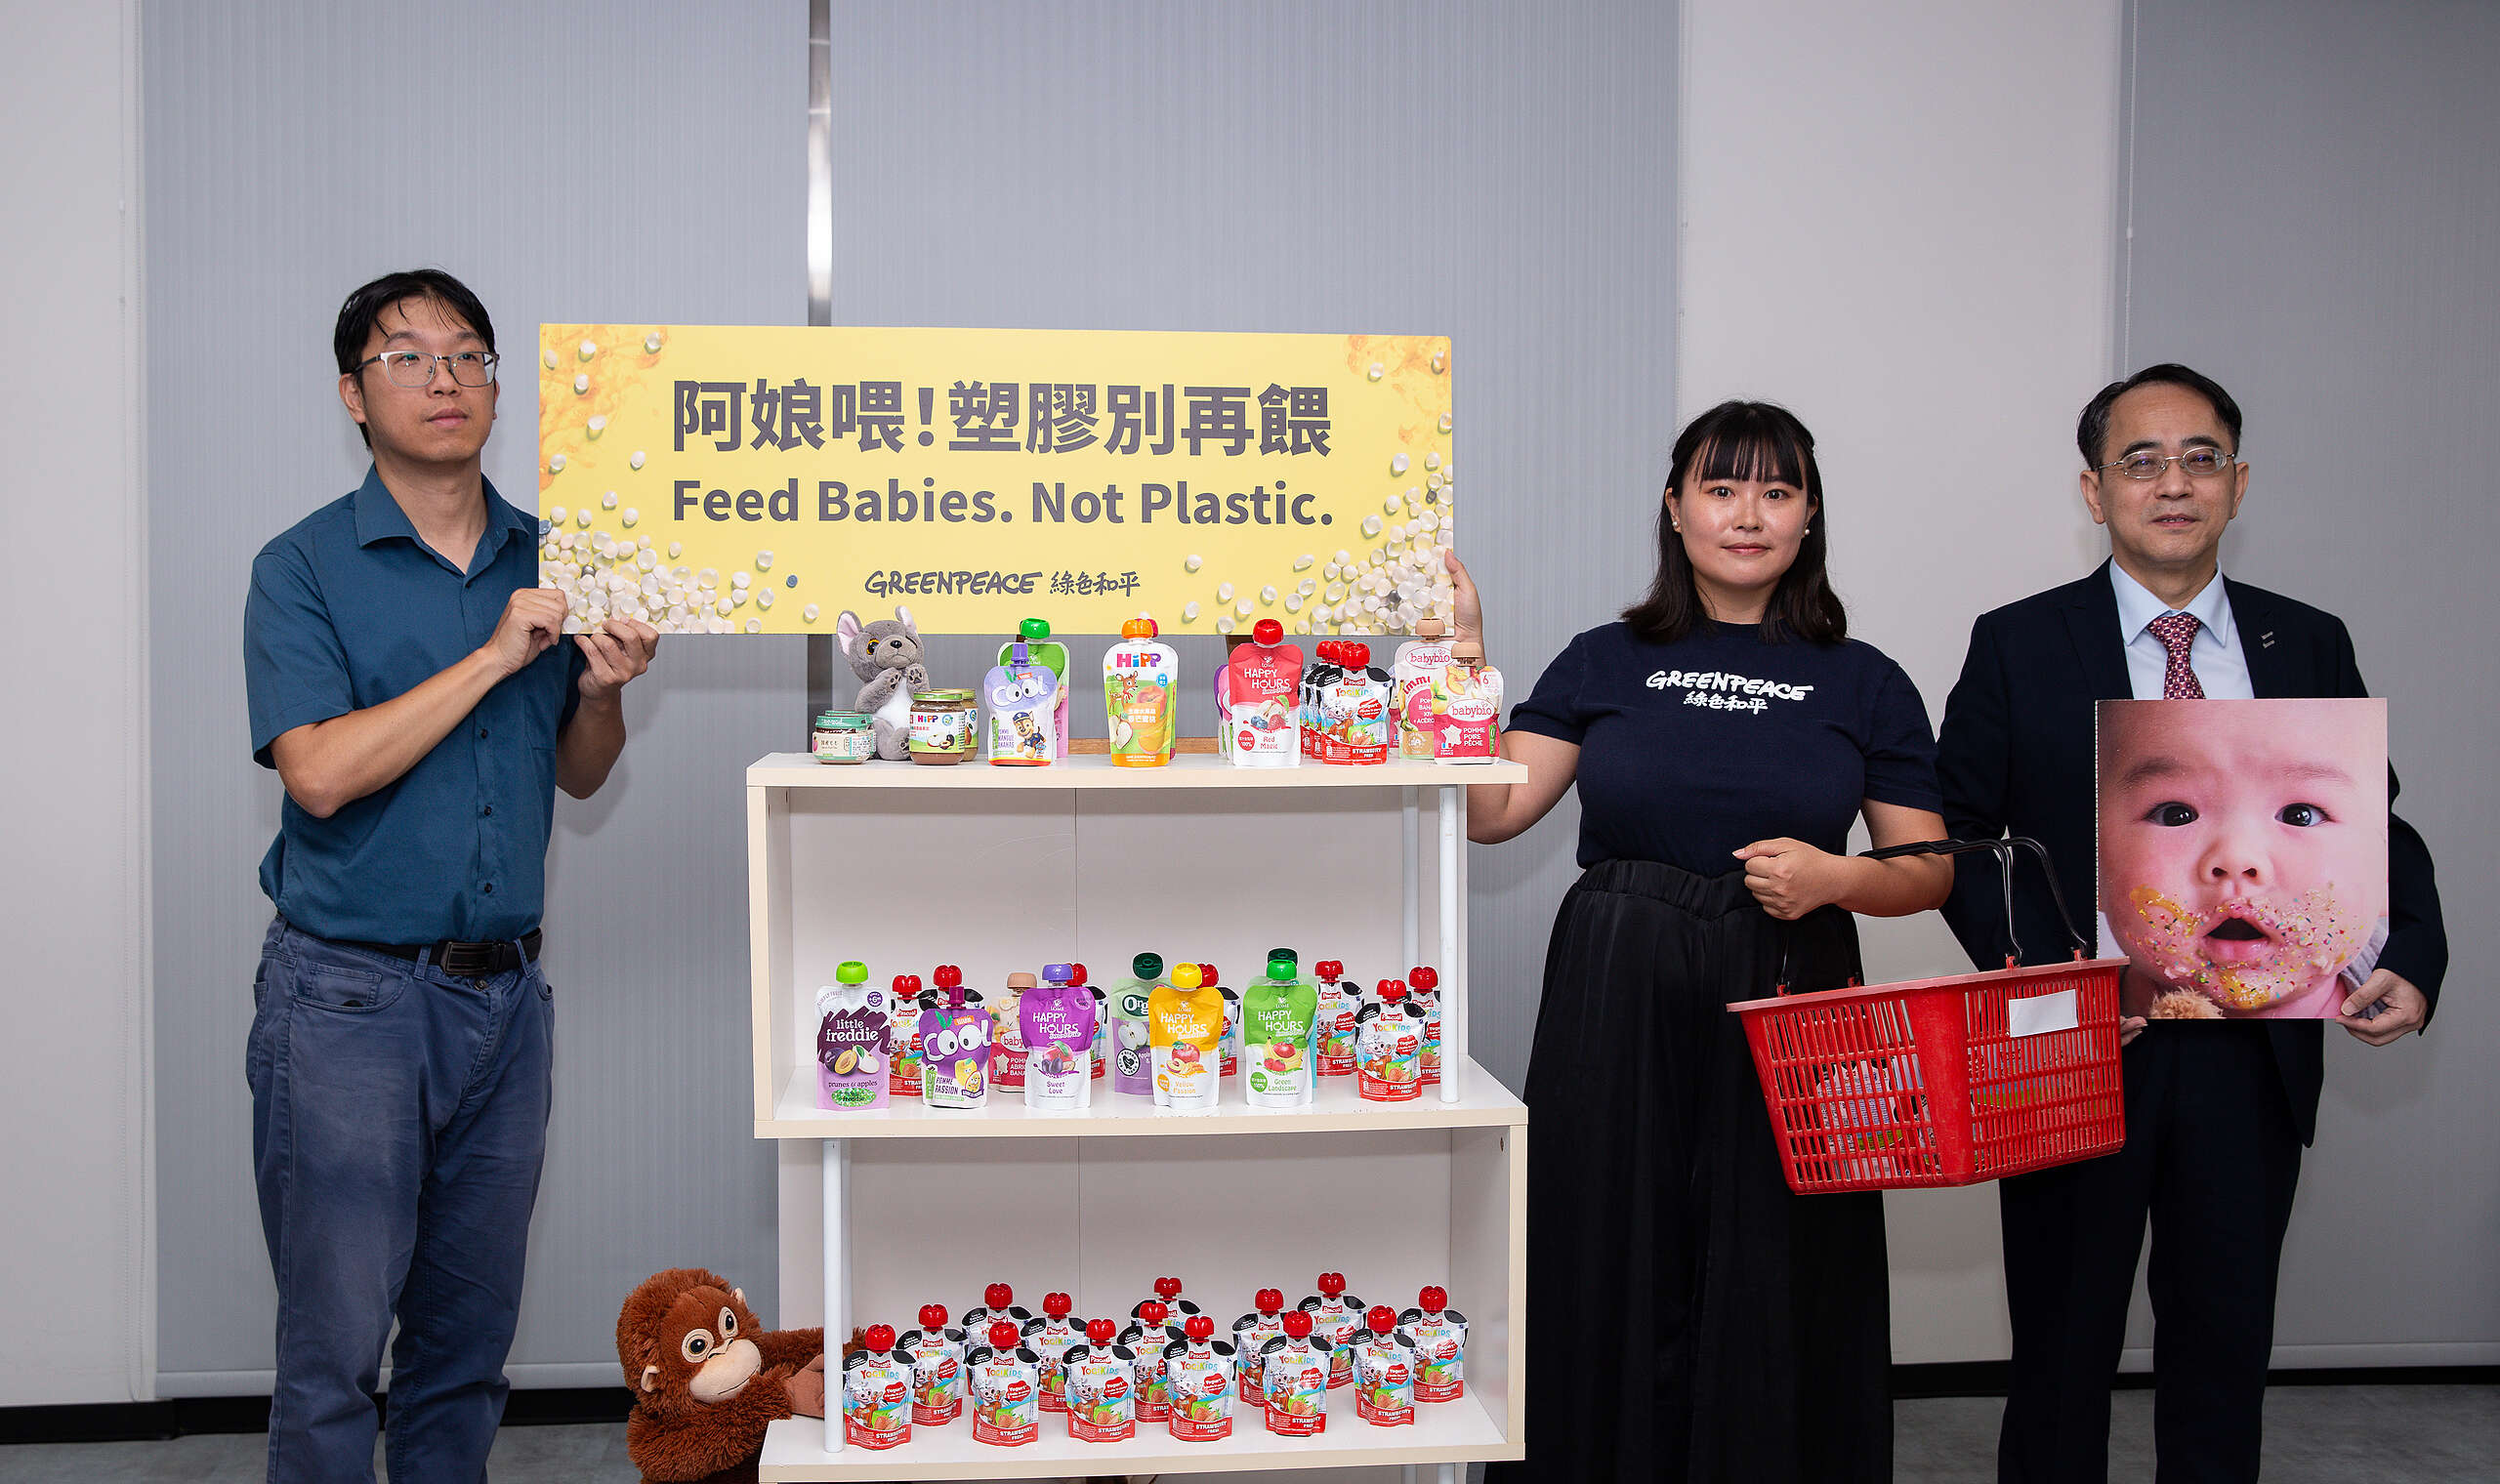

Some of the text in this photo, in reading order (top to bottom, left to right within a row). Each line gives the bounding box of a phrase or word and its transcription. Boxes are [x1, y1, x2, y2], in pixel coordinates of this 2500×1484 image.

[673, 377, 1331, 457] 阿娘喂!塑膠別再餵
[674, 476, 1333, 526] Feed Babies. Not Plastic.
[864, 570, 1141, 598] GREENPEACE 綠色和平
[1116, 652, 1162, 668] HiPP
[1409, 652, 1450, 665] babybio
[1243, 668, 1277, 679] HAPPY
[1250, 678, 1290, 689] HOURS
[1646, 670, 1814, 701] GREENPEACE
[1683, 690, 1769, 715] 綠色和平
[1451, 706, 1493, 717] babybio
[1033, 1011, 1067, 1022] HAPPY
[1160, 1012, 1195, 1023] HAPPY
[1258, 1010, 1292, 1020] HAPPY
[836, 1019, 864, 1029] little
[1039, 1023, 1079, 1034] HOURS
[1167, 1024, 1207, 1035] HOURS
[1265, 1021, 1304, 1032] HOURS
[826, 1026, 879, 1043] freddie
